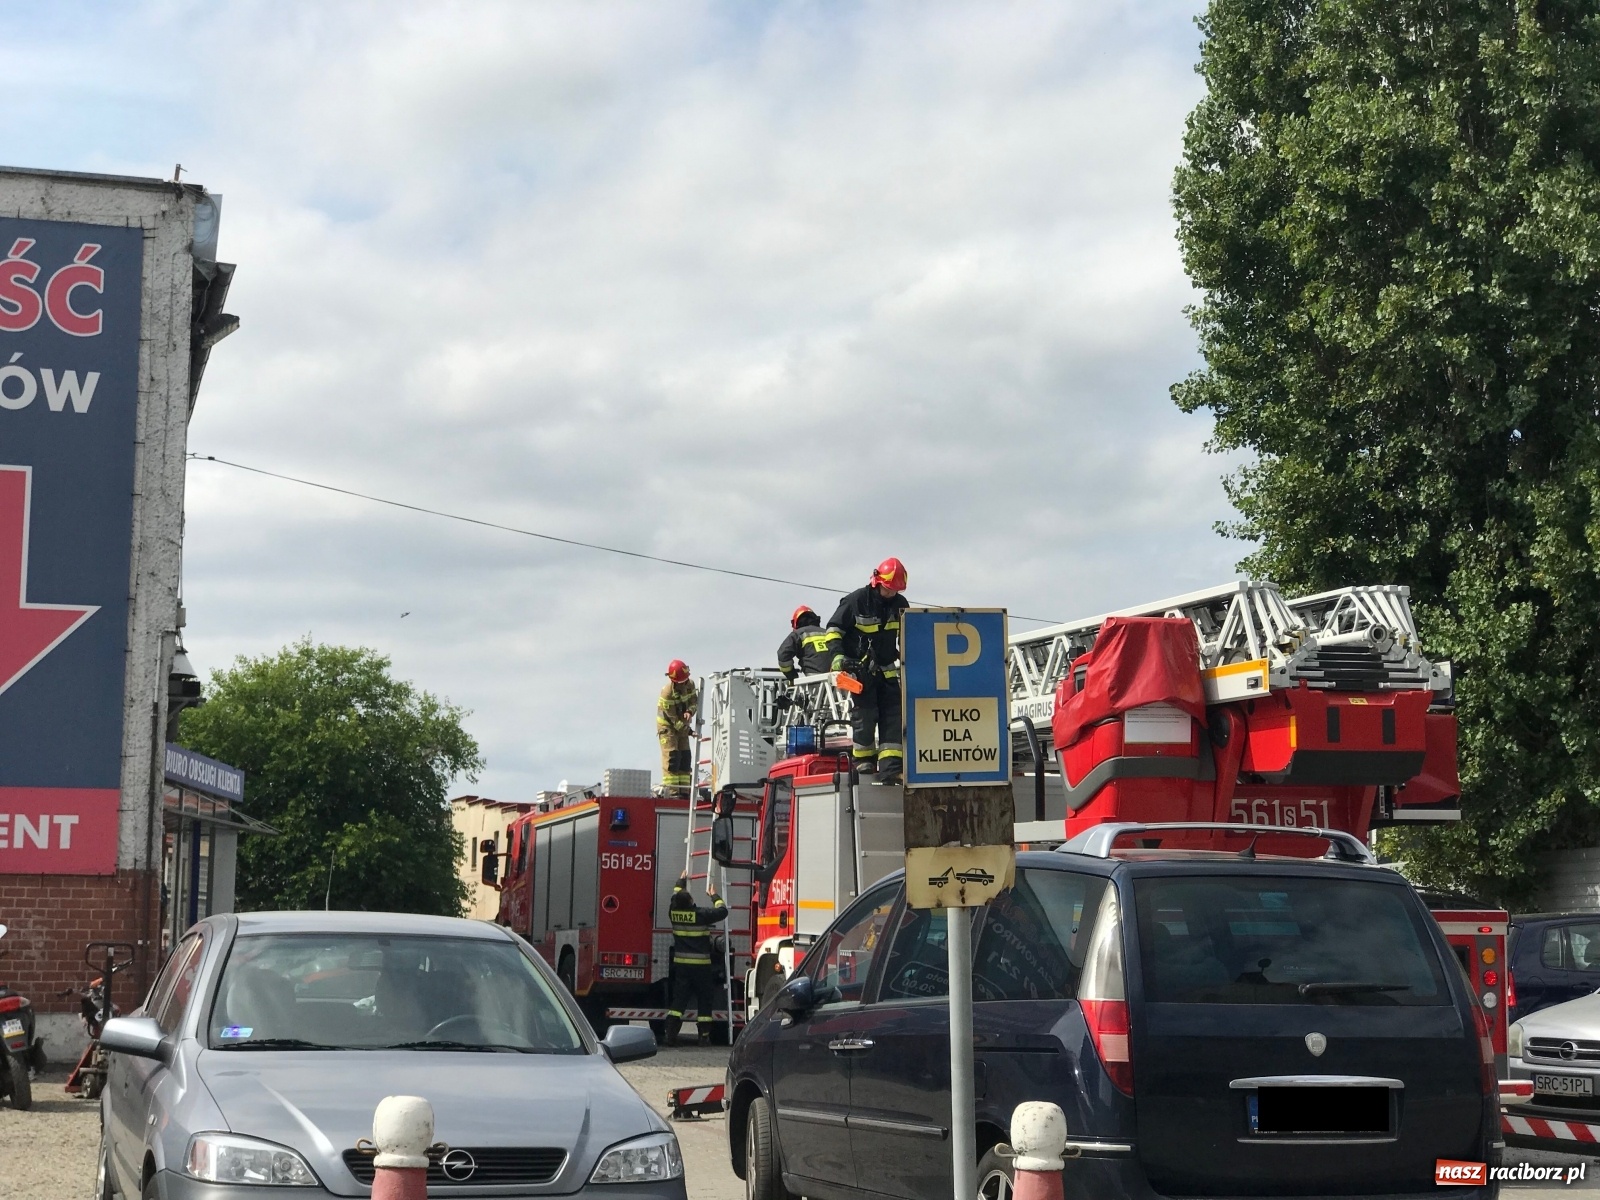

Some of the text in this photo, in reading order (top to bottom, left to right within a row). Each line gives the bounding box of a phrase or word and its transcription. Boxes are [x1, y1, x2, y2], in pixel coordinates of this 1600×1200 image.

[0, 352, 101, 413] ÓW
[933, 622, 982, 691] P
[931, 708, 981, 722] TYLKO
[1017, 701, 1053, 718] MAGIRUS
[943, 728, 973, 742] DLA
[918, 745, 997, 762] KLIENTÓW
[165, 749, 241, 795] BIURO OBSŁUGI KLIENTA
[672, 912, 694, 922] STRAŻ
[1537, 1076, 1590, 1093] SRC 51PL
